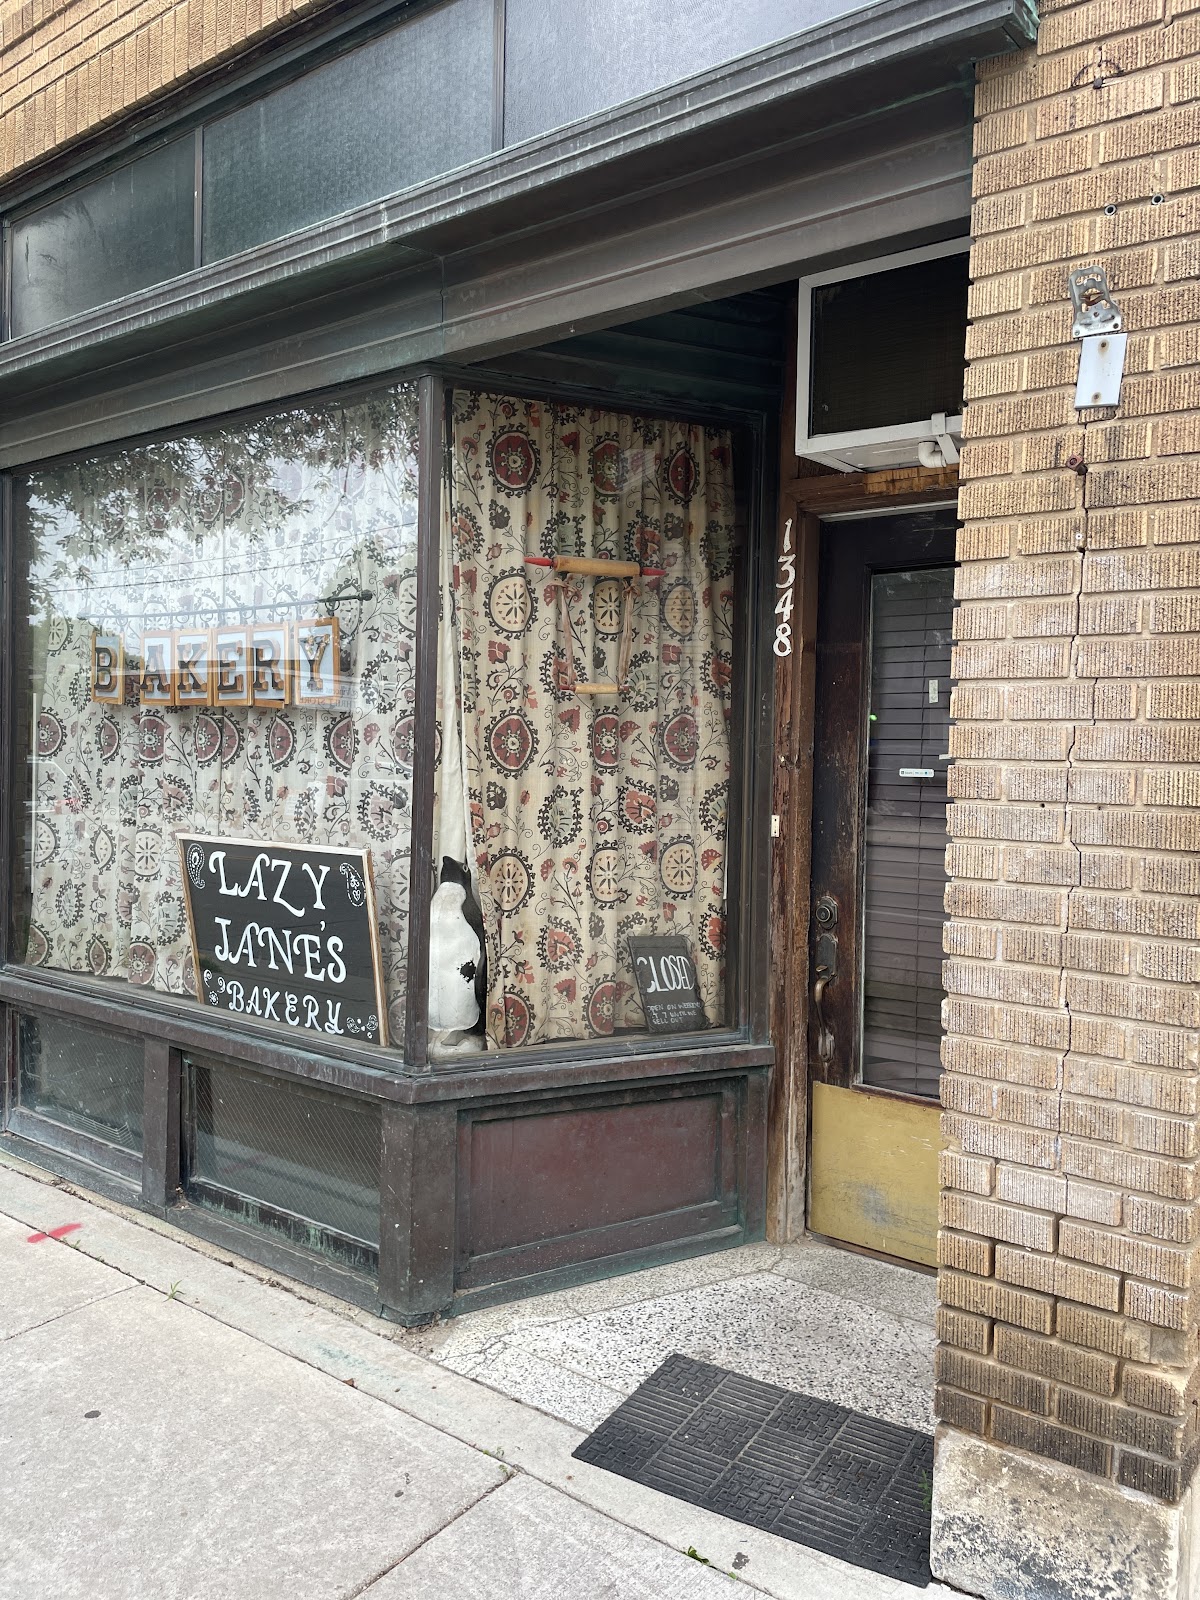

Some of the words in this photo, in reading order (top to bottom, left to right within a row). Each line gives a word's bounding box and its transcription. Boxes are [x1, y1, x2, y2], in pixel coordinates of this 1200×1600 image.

[772, 517, 797, 657] 1348
[93, 633, 331, 694] BAKERY
[208, 850, 331, 918] LAZY
[214, 916, 347, 984] JANE'S
[636, 954, 695, 993] CLOSED
[226, 980, 345, 1035] BAKERY
